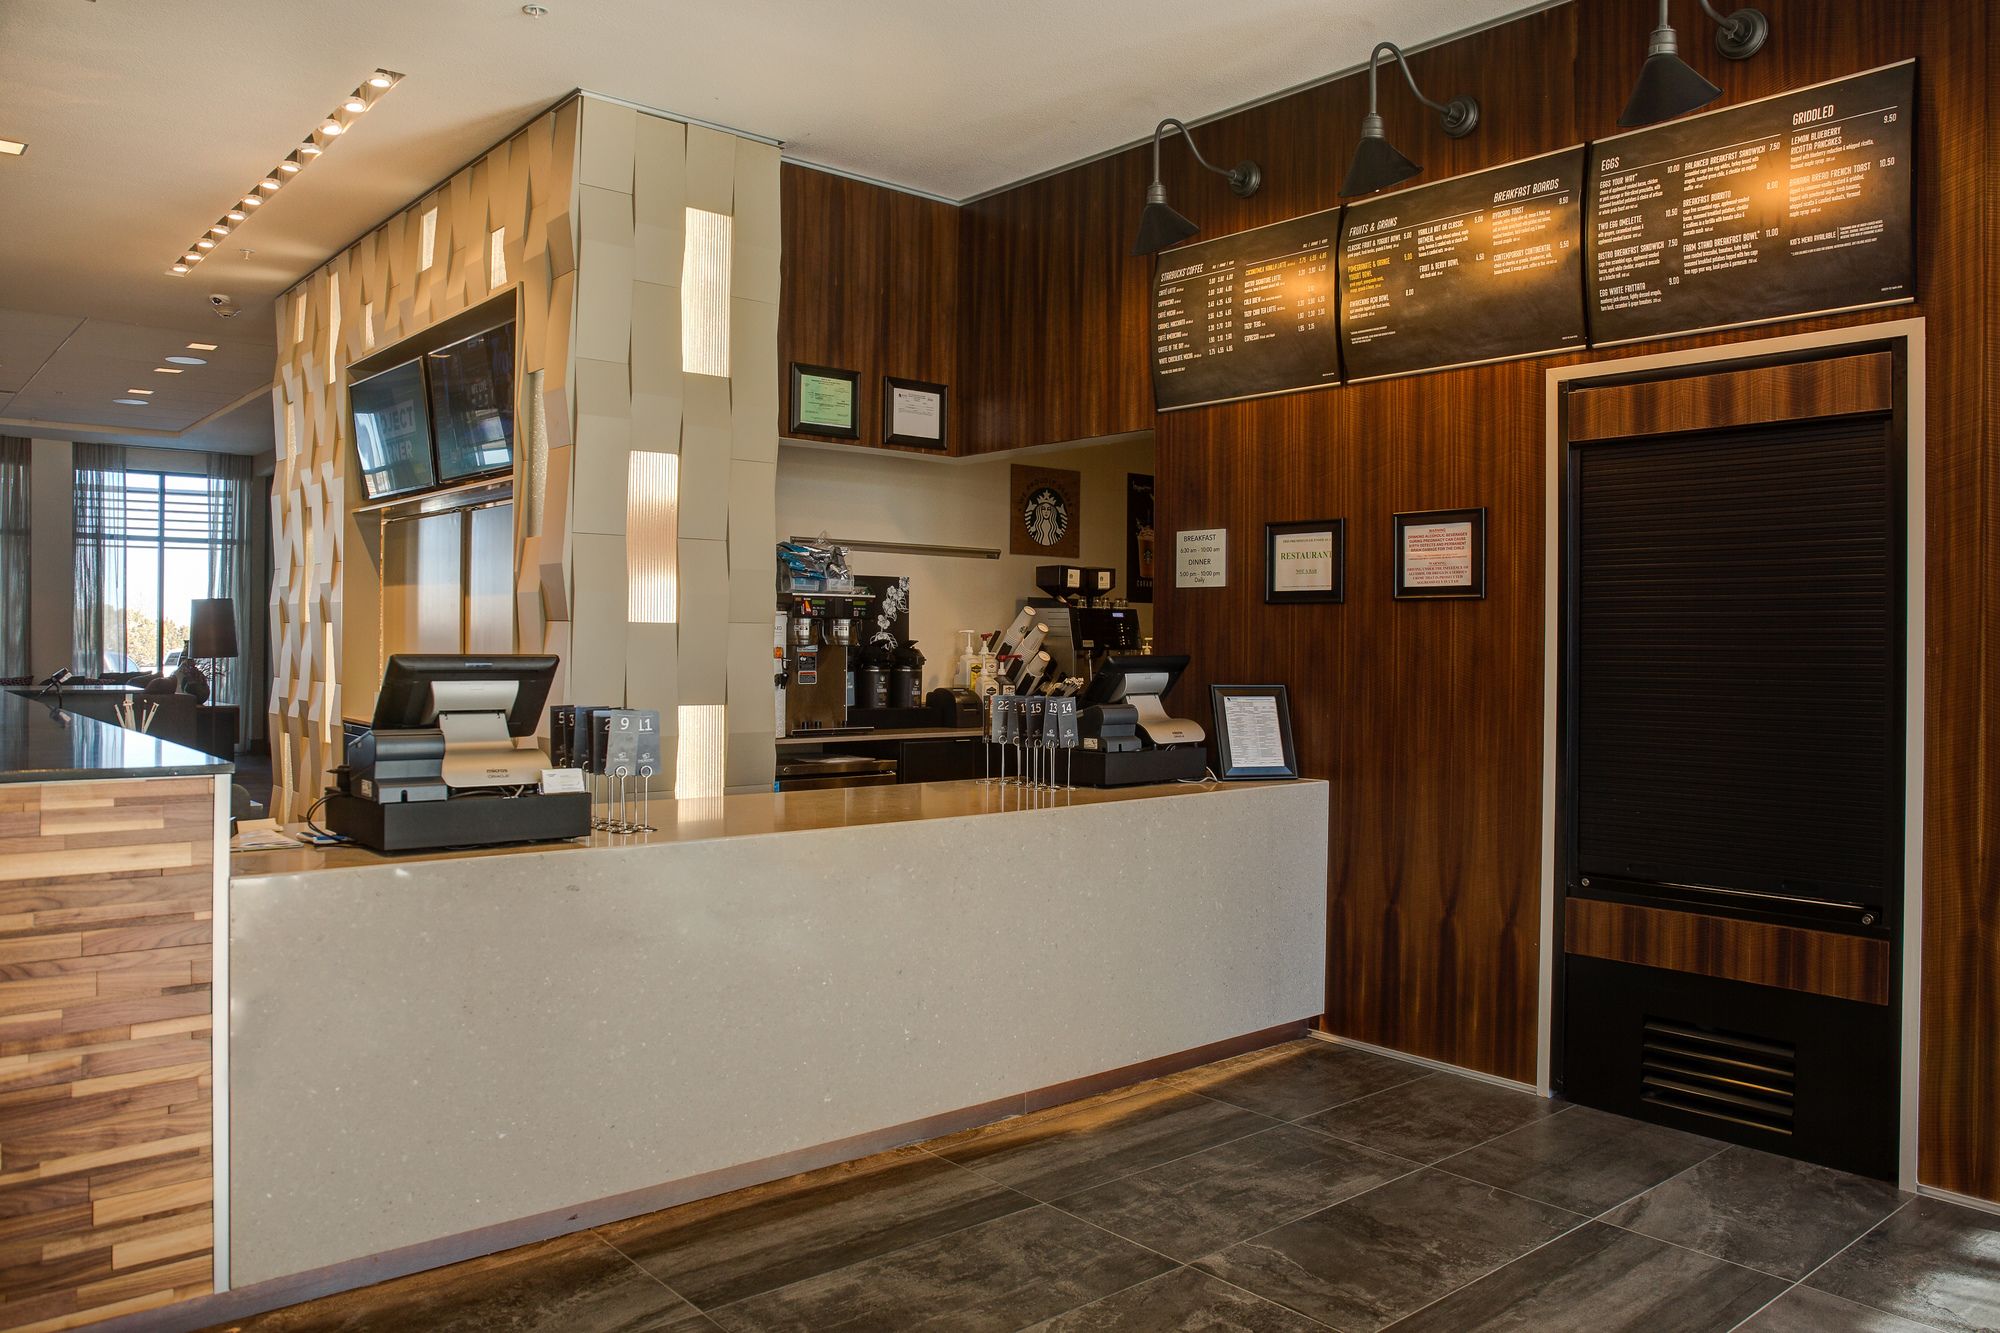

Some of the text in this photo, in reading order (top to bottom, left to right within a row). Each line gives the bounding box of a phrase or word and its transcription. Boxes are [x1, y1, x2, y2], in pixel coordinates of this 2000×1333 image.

[1792, 104, 1834, 126] GRIDDLED
[1884, 113, 1896, 124] 9.50
[1791, 126, 1842, 146] LEMON BLUEBERRY
[1769, 142, 1780, 152] 7.50
[1790, 136, 1842, 155] RICOTTA PANCAKES
[1601, 157, 1620, 171] EGGS
[1685, 145, 1766, 170] BALANCED BREAKFAST SANDWICH
[1880, 156, 1895, 167] 10.50
[1812, 172, 1829, 182] BREAD
[1830, 166, 1852, 178] FRENCH
[1854, 162, 1871, 173] TOAST
[1600, 180, 1611, 189] EGGS
[1612, 176, 1624, 186] YOUR
[1493, 178, 1559, 202] BREAKFAST BOARDS
[1683, 190, 1732, 207] BREAKFAST BURRITO
[1666, 208, 1678, 217] 10.50
[1349, 217, 1397, 237] FRUITS & GRAINS
[1598, 215, 1642, 230] TWO EGG OMELETTE
[1766, 228, 1778, 237] 11.00
[1801, 236, 1813, 244] MENU
[1814, 231, 1836, 242] AVAILABLE
[1668, 238, 1678, 247] 7.50
[1683, 243, 1696, 252] FARM
[1698, 240, 1713, 250] STAND
[1714, 234, 1742, 247] BREAKFAST
[1598, 241, 1664, 260] BISTRO BREAKFAST SANDWICH
[1187, 264, 1204, 276] COFFEE
[1669, 276, 1680, 285] 9.00
[1600, 289, 1608, 297] EGG
[1609, 286, 1624, 295] WHITE
[1184, 534, 1216, 542] BREAKFAST
[1030, 703, 1041, 713] 15
[1049, 702, 1057, 713] 13
[1061, 703, 1072, 713] 14
[569, 714, 575, 726] 3
[620, 717, 629, 730] 9
[639, 718, 652, 731] 11
